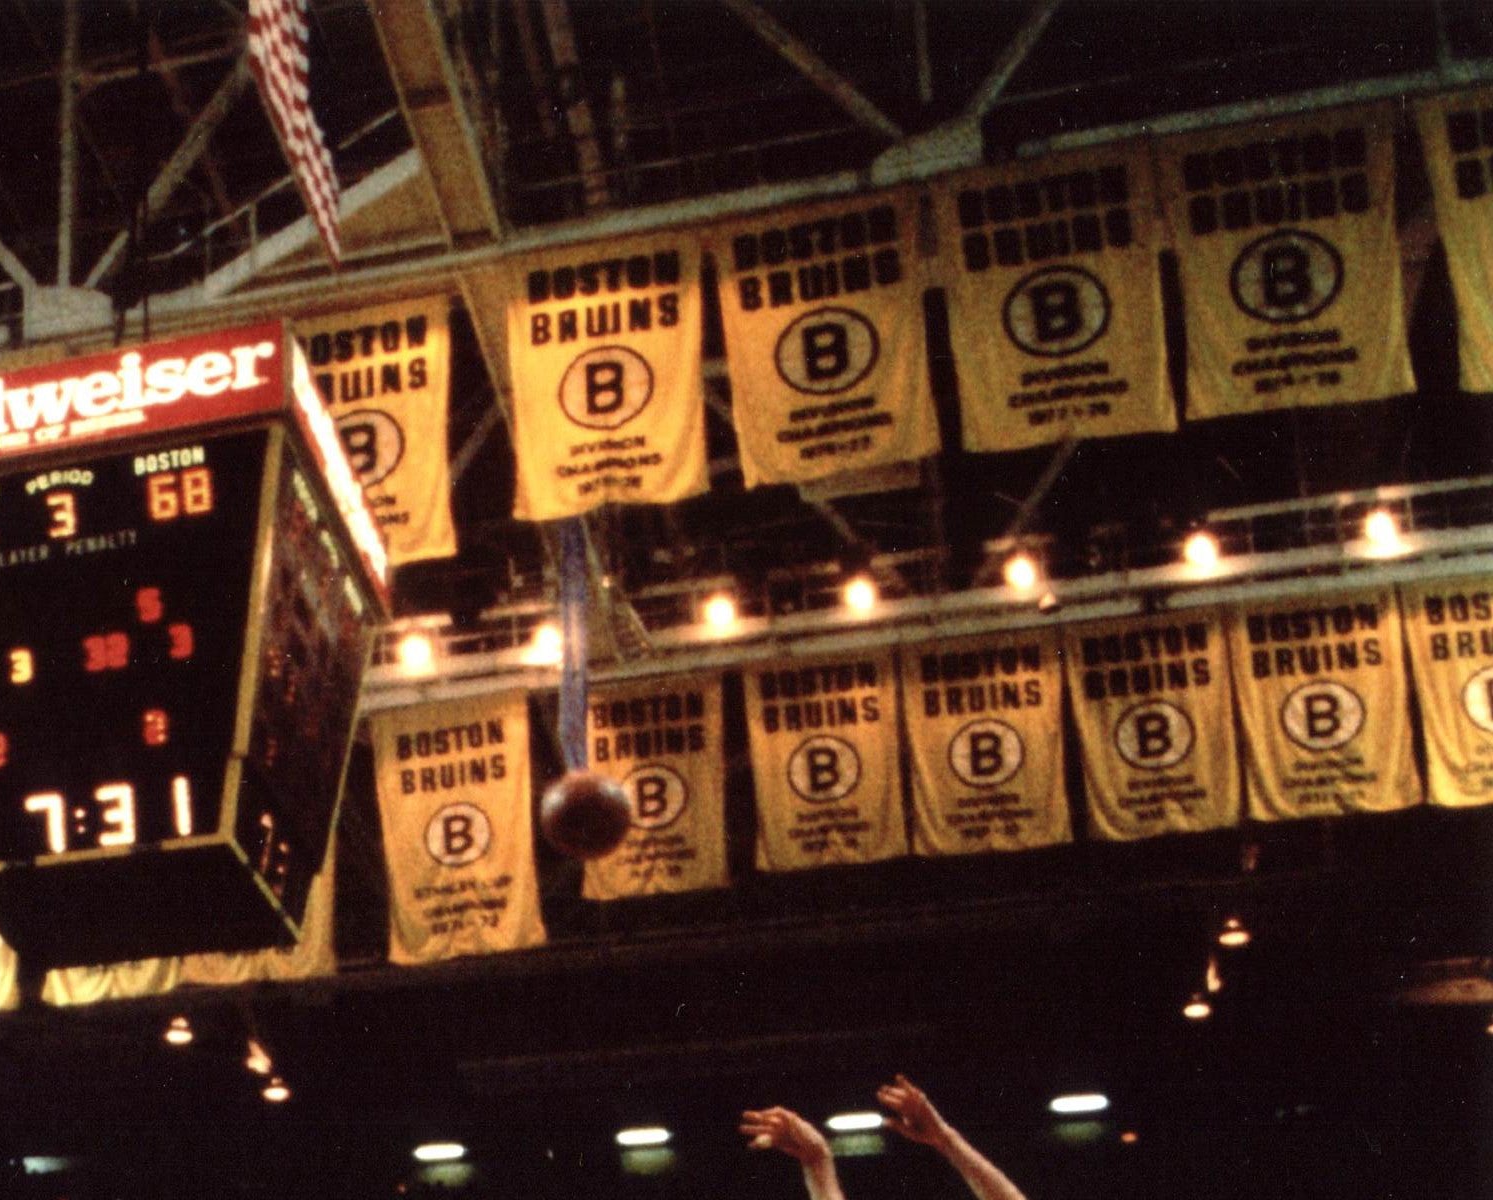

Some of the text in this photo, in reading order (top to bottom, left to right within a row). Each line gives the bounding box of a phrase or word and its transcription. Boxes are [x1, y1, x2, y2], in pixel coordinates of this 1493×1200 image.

[1262, 246, 1310, 305] B
[531, 292, 679, 346] BRUINS
[1033, 281, 1084, 342] B
[310, 314, 427, 366] OSTON
[802, 322, 848, 381] B
[322, 358, 427, 404] RUINS
[585, 361, 624, 416] B
[25, 469, 93, 496] PERIOD
[134, 447, 204, 476] BOSTON
[46, 493, 77, 538] 3
[147, 468, 214, 522] 68
[1247, 604, 1378, 644] BOSTON
[10, 648, 34, 684] 3
[1085, 658, 1209, 699] BRUINS
[1252, 638, 1383, 679] BRUINS
[593, 692, 704, 730] BOSTON
[763, 696, 880, 734] BRUINS
[924, 679, 1042, 718] BRUINS
[1307, 694, 1339, 737] B
[396, 718, 504, 761] BOSTON
[595, 725, 705, 762] BRUINS
[970, 732, 1002, 776] B
[1135, 712, 1170, 757] B
[401, 755, 507, 794] BRUINS
[808, 748, 839, 792] B
[637, 775, 667, 819] B
[444, 815, 473, 855] B
